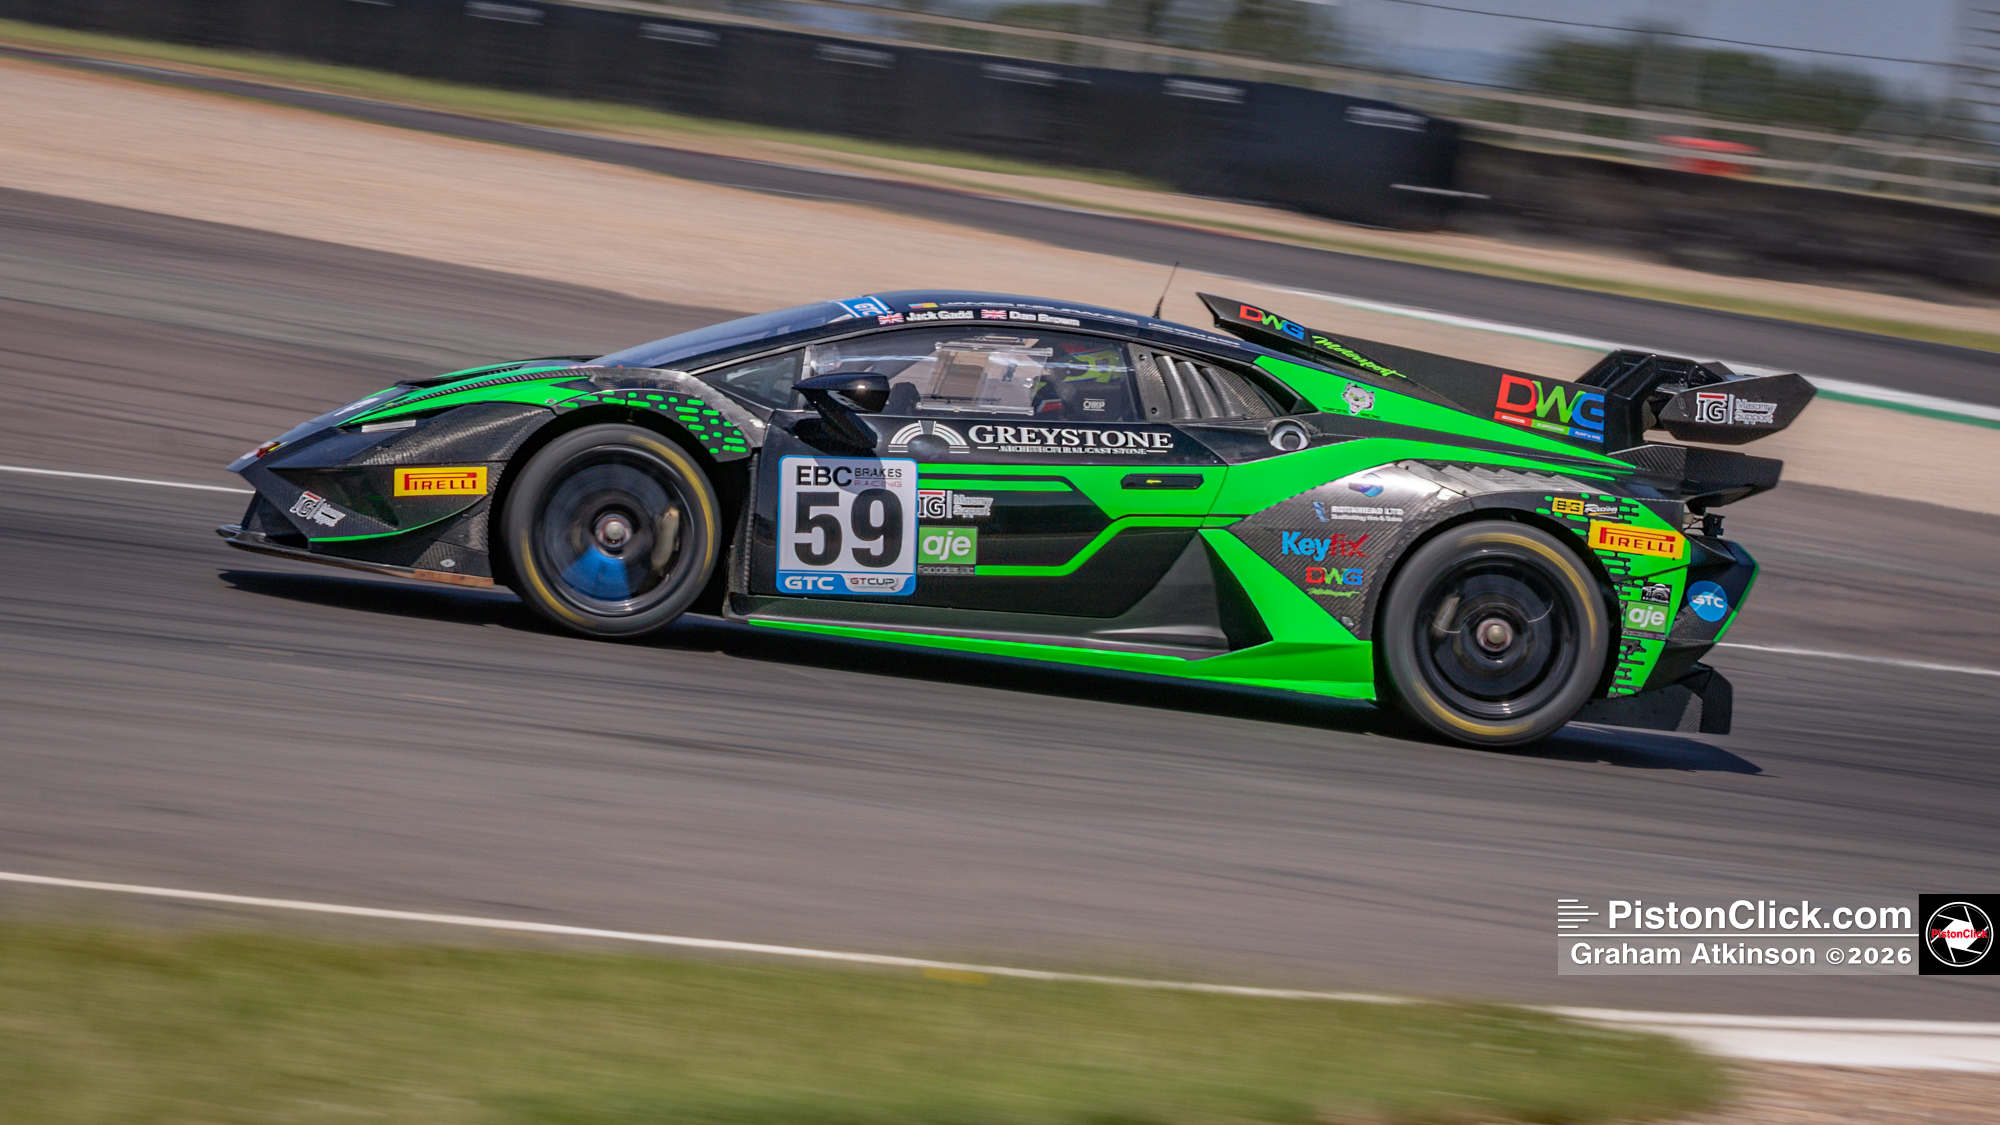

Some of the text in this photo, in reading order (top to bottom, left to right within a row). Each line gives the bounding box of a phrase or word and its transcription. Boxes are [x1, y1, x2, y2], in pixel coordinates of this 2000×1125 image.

[906, 311, 938, 321] Jack
[1009, 311, 1036, 321] Dan
[1239, 304, 1304, 340] DWG
[1311, 335, 1407, 377] Motorsport
[1083, 400, 1105, 409] OMP
[1496, 373, 1605, 431] DWG
[968, 424, 1174, 449] GREYSTONE
[404, 472, 477, 490] PIRELLI
[796, 465, 903, 487] EBC BRAKES
[854, 480, 903, 488] RACING
[794, 488, 903, 568] 59
[923, 530, 972, 561] aje
[1599, 527, 1676, 553] PIRELLI
[784, 576, 834, 590] GTC
[1306, 567, 1363, 586] DWG
[1628, 605, 1665, 628] aje
